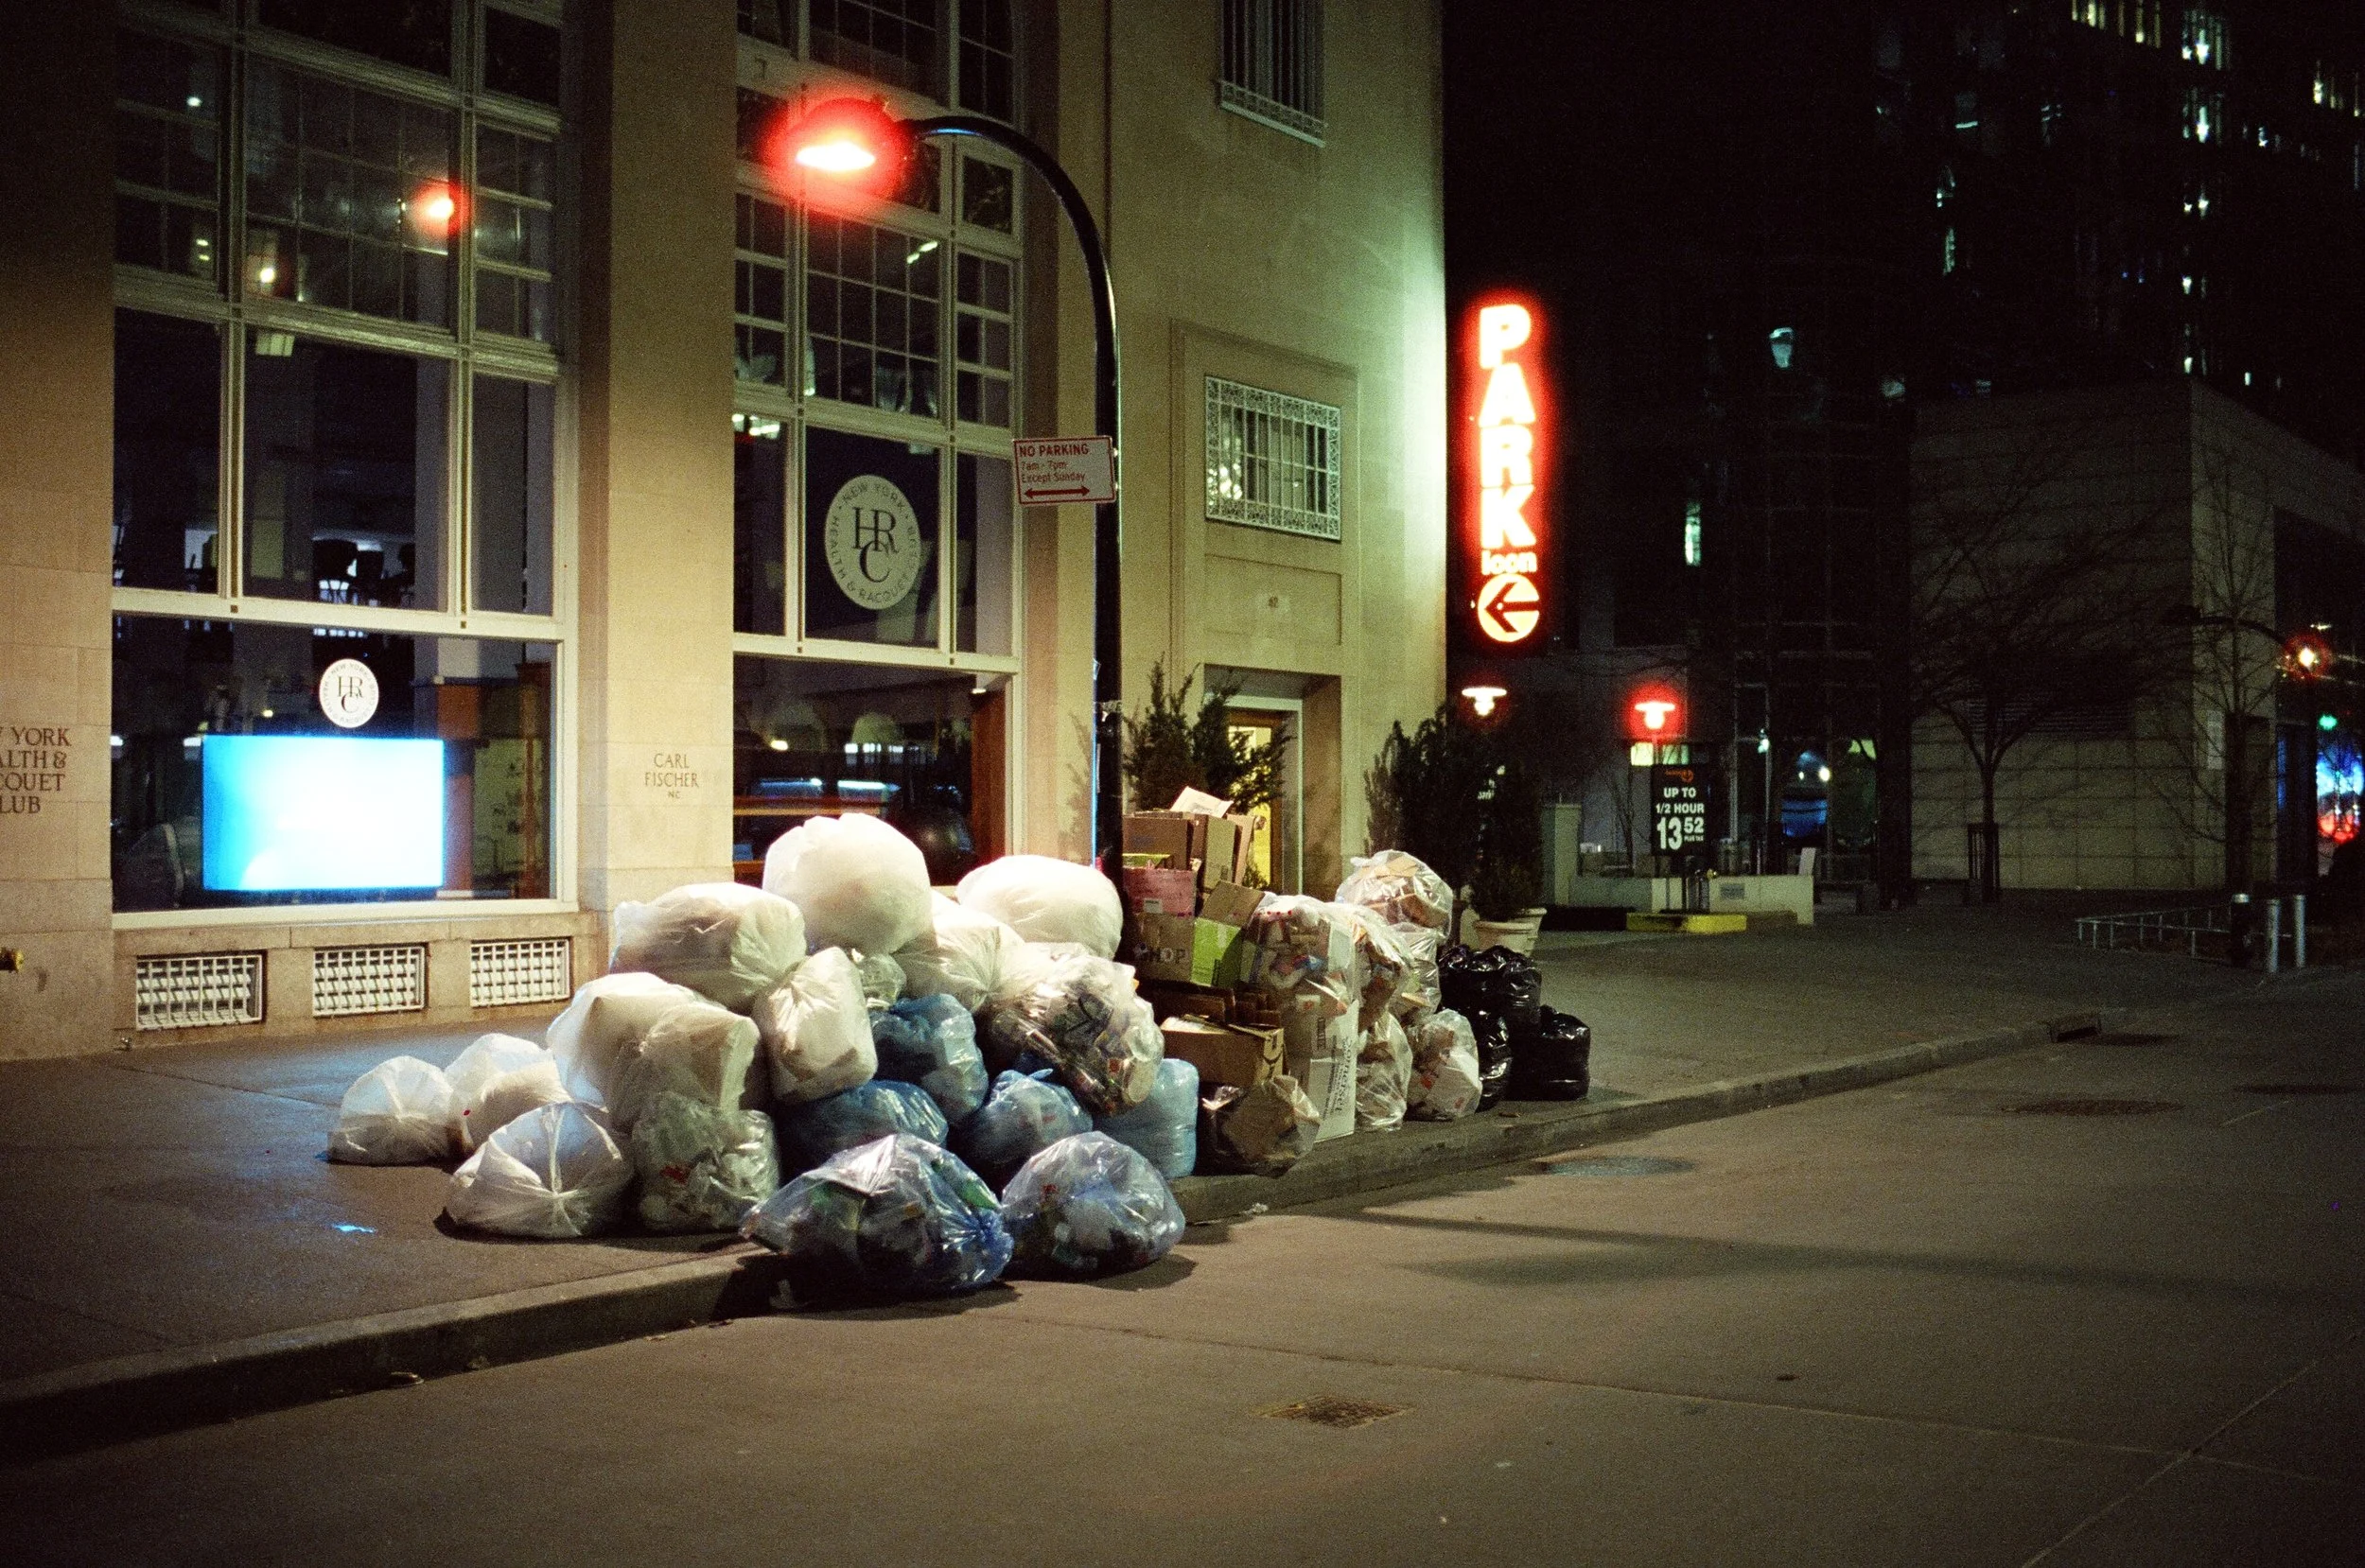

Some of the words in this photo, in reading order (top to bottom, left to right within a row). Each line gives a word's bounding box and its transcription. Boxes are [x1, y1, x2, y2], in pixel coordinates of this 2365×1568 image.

[1479, 303, 1537, 549] PARK
[1019, 445, 1036, 457] NO
[1040, 444, 1090, 457] PARKING
[1048, 460, 1068, 471] 7pm
[1022, 473, 1051, 483] Except
[1054, 471, 1085, 482] Sunday
[842, 482, 868, 503] NEW
[874, 483, 905, 512] YORK
[10, 726, 72, 746] YORK
[53, 751, 67, 769] &
[654, 753, 690, 768] CARL
[0, 772, 65, 792] QUET
[644, 772, 699, 787] FISCHER
[1664, 787, 1679, 798] UP
[1681, 787, 1696, 798] TO
[1656, 803, 1671, 814] 1/2
[1673, 803, 1705, 814] HOUR
